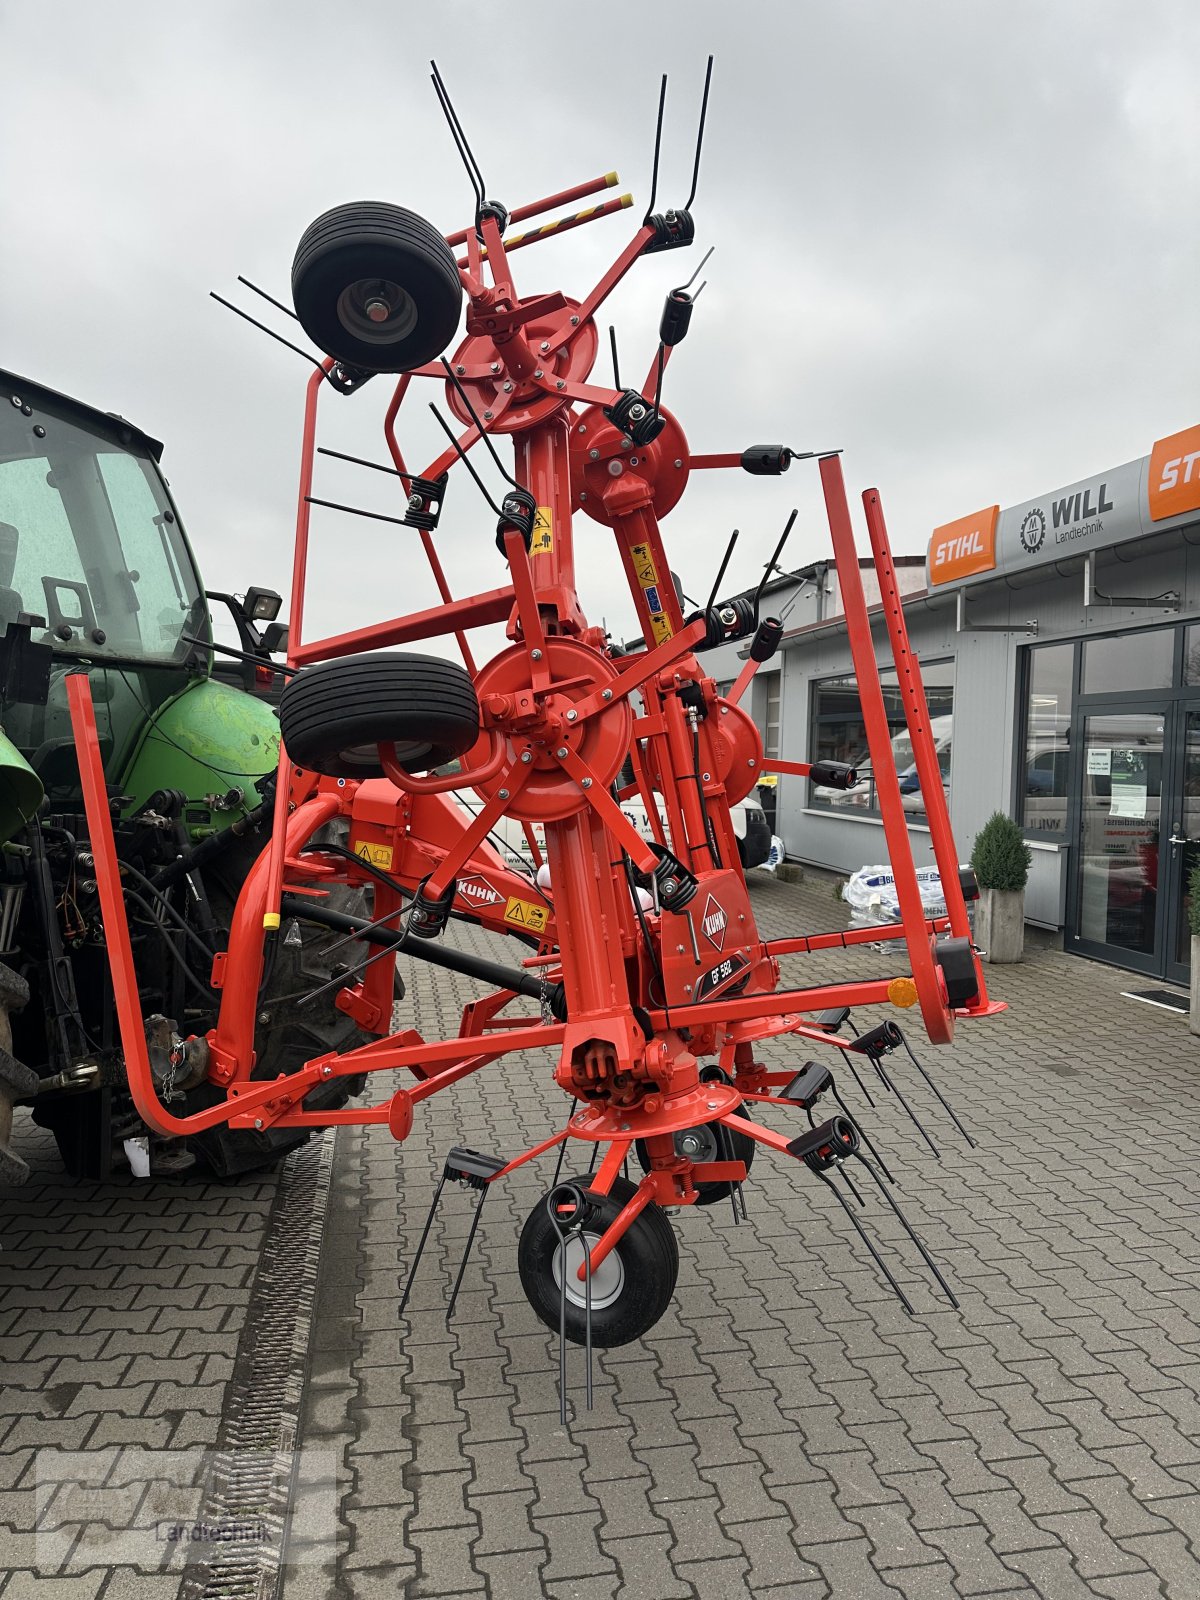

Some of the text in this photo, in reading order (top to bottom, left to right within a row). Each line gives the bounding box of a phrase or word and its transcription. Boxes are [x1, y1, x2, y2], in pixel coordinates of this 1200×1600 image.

[1159, 450, 1200, 492] ST
[1052, 484, 1113, 528] WILL
[1055, 519, 1104, 544] Landtechnik
[935, 531, 984, 566] STIHL
[458, 881, 496, 903] KUHN
[705, 911, 725, 937] KUHN
[711, 960, 732, 985] GF 582
